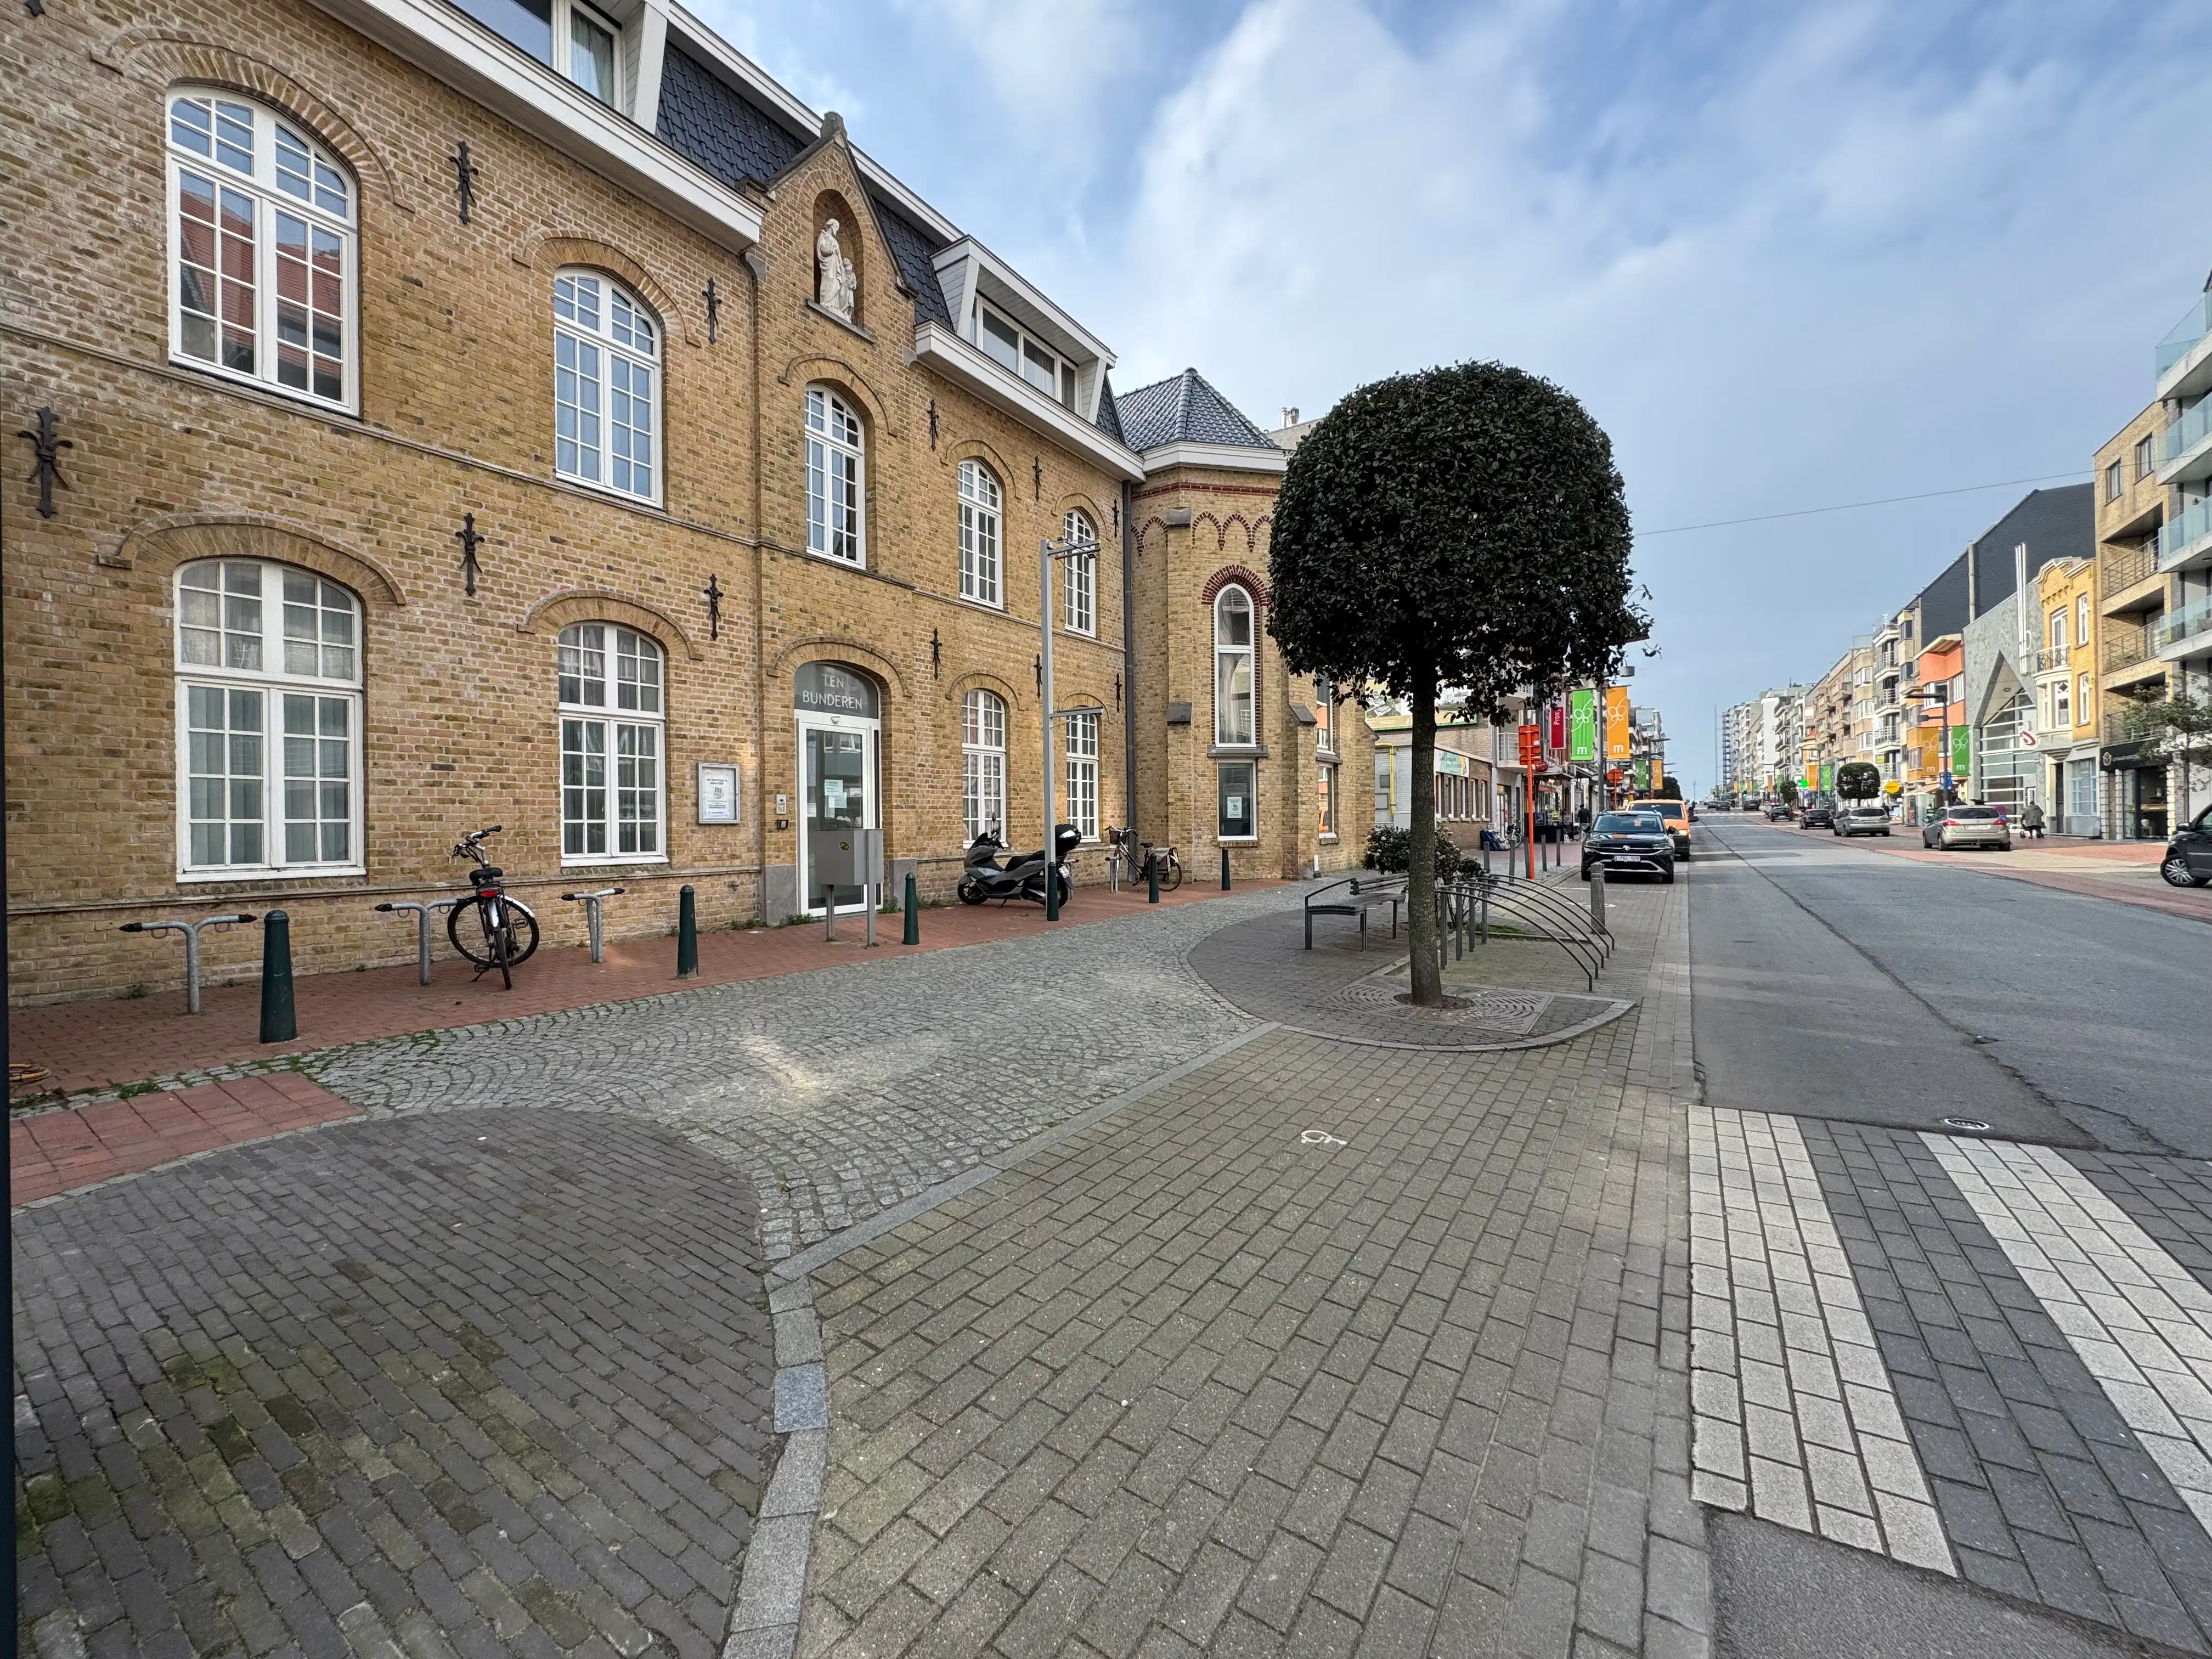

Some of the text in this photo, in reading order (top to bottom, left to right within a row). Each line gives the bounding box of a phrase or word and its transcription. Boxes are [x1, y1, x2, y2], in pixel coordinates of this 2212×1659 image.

[822, 674, 844, 688] TEN
[803, 690, 862, 710] BUNDEREN
[1577, 746, 1587, 755] m
[1613, 744, 1624, 753] m
